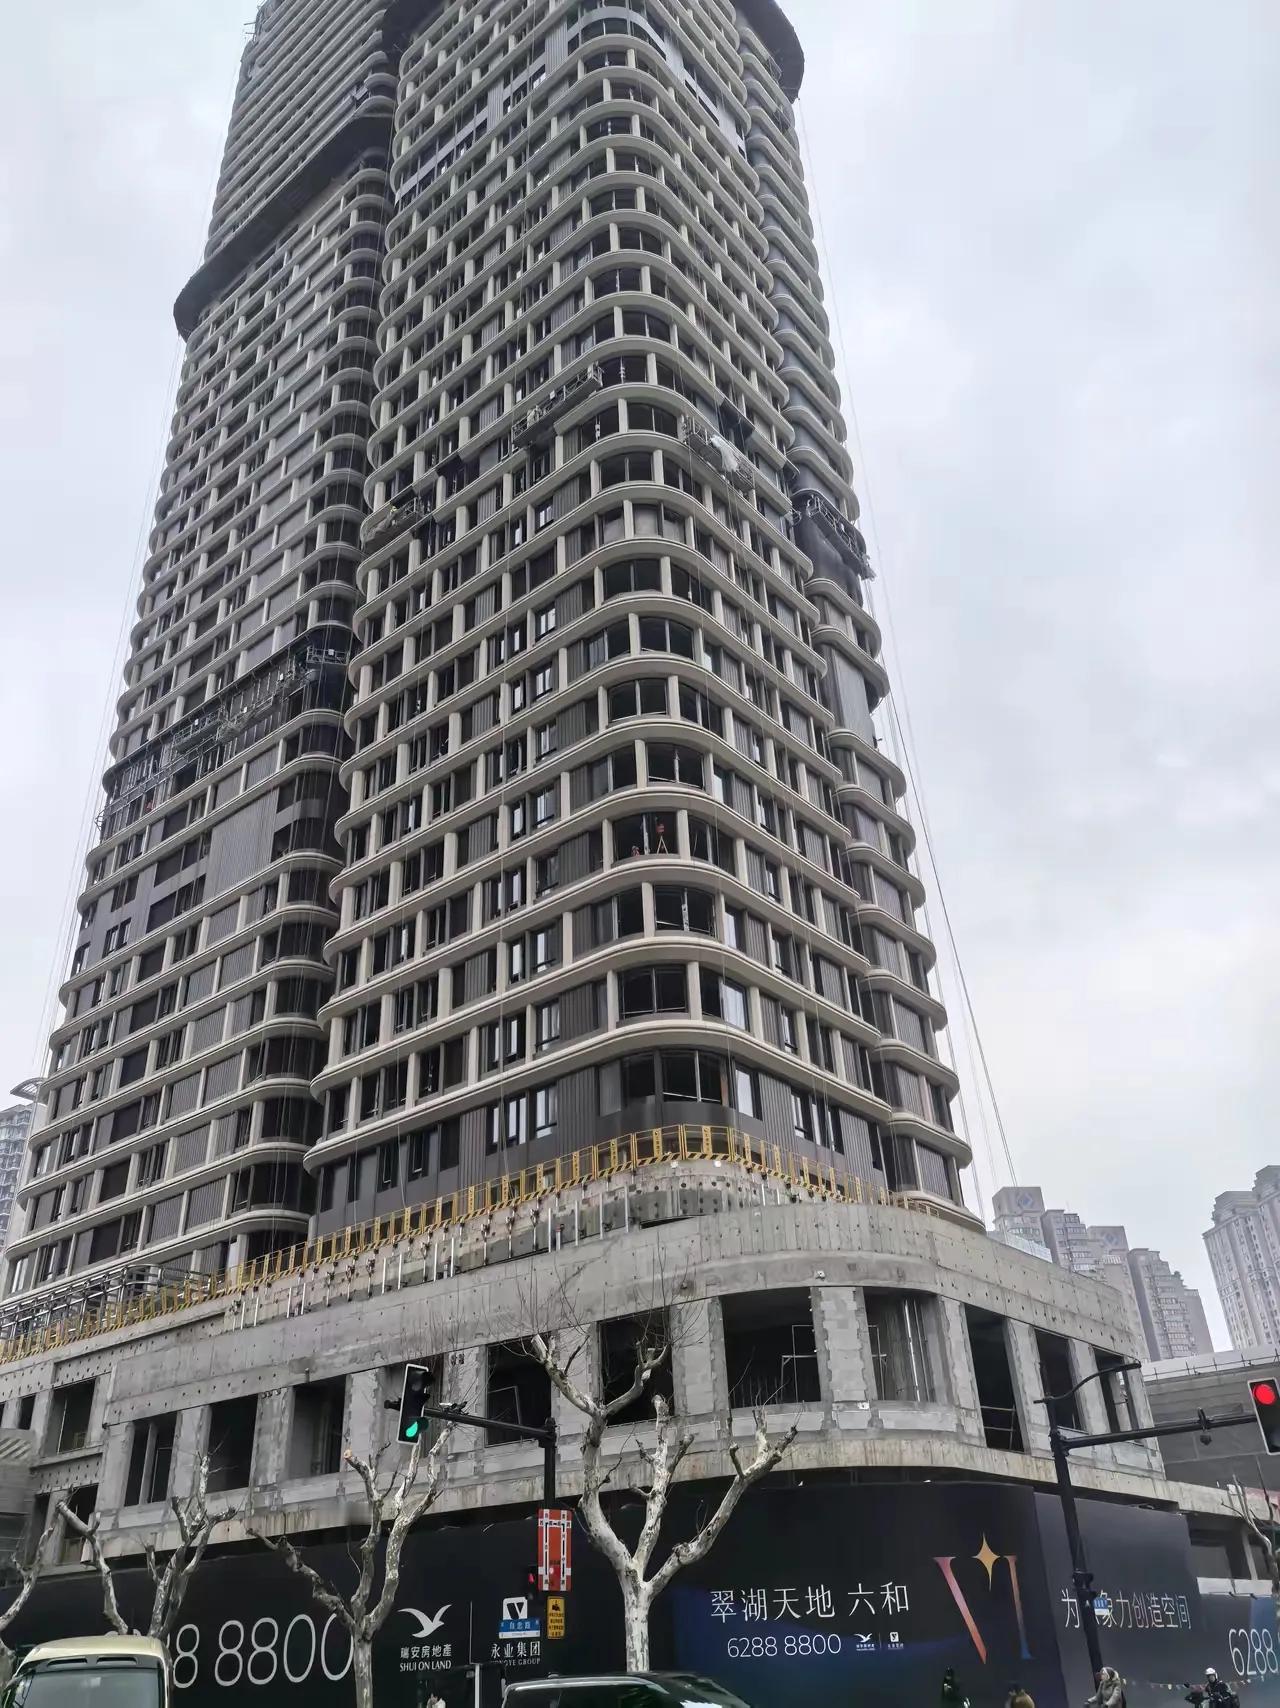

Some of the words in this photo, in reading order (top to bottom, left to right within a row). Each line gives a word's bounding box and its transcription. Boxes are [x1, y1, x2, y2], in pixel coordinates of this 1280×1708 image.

[710, 1583, 836, 1623] 翠湖天地
[847, 1581, 909, 1617] 六和
[1061, 1588, 1192, 1629] 为象力创造空间
[214, 1613, 354, 1687] 8800
[490, 1640, 541, 1659] 永业集团
[518, 1657, 541, 1666] GROUP
[727, 1636, 778, 1658] 6288
[784, 1633, 841, 1656] 8800
[1228, 1628, 1279, 1676] 6288
[399, 1662, 417, 1672] SHUI
[418, 1661, 431, 1671] ON
[431, 1659, 452, 1670] LAND
